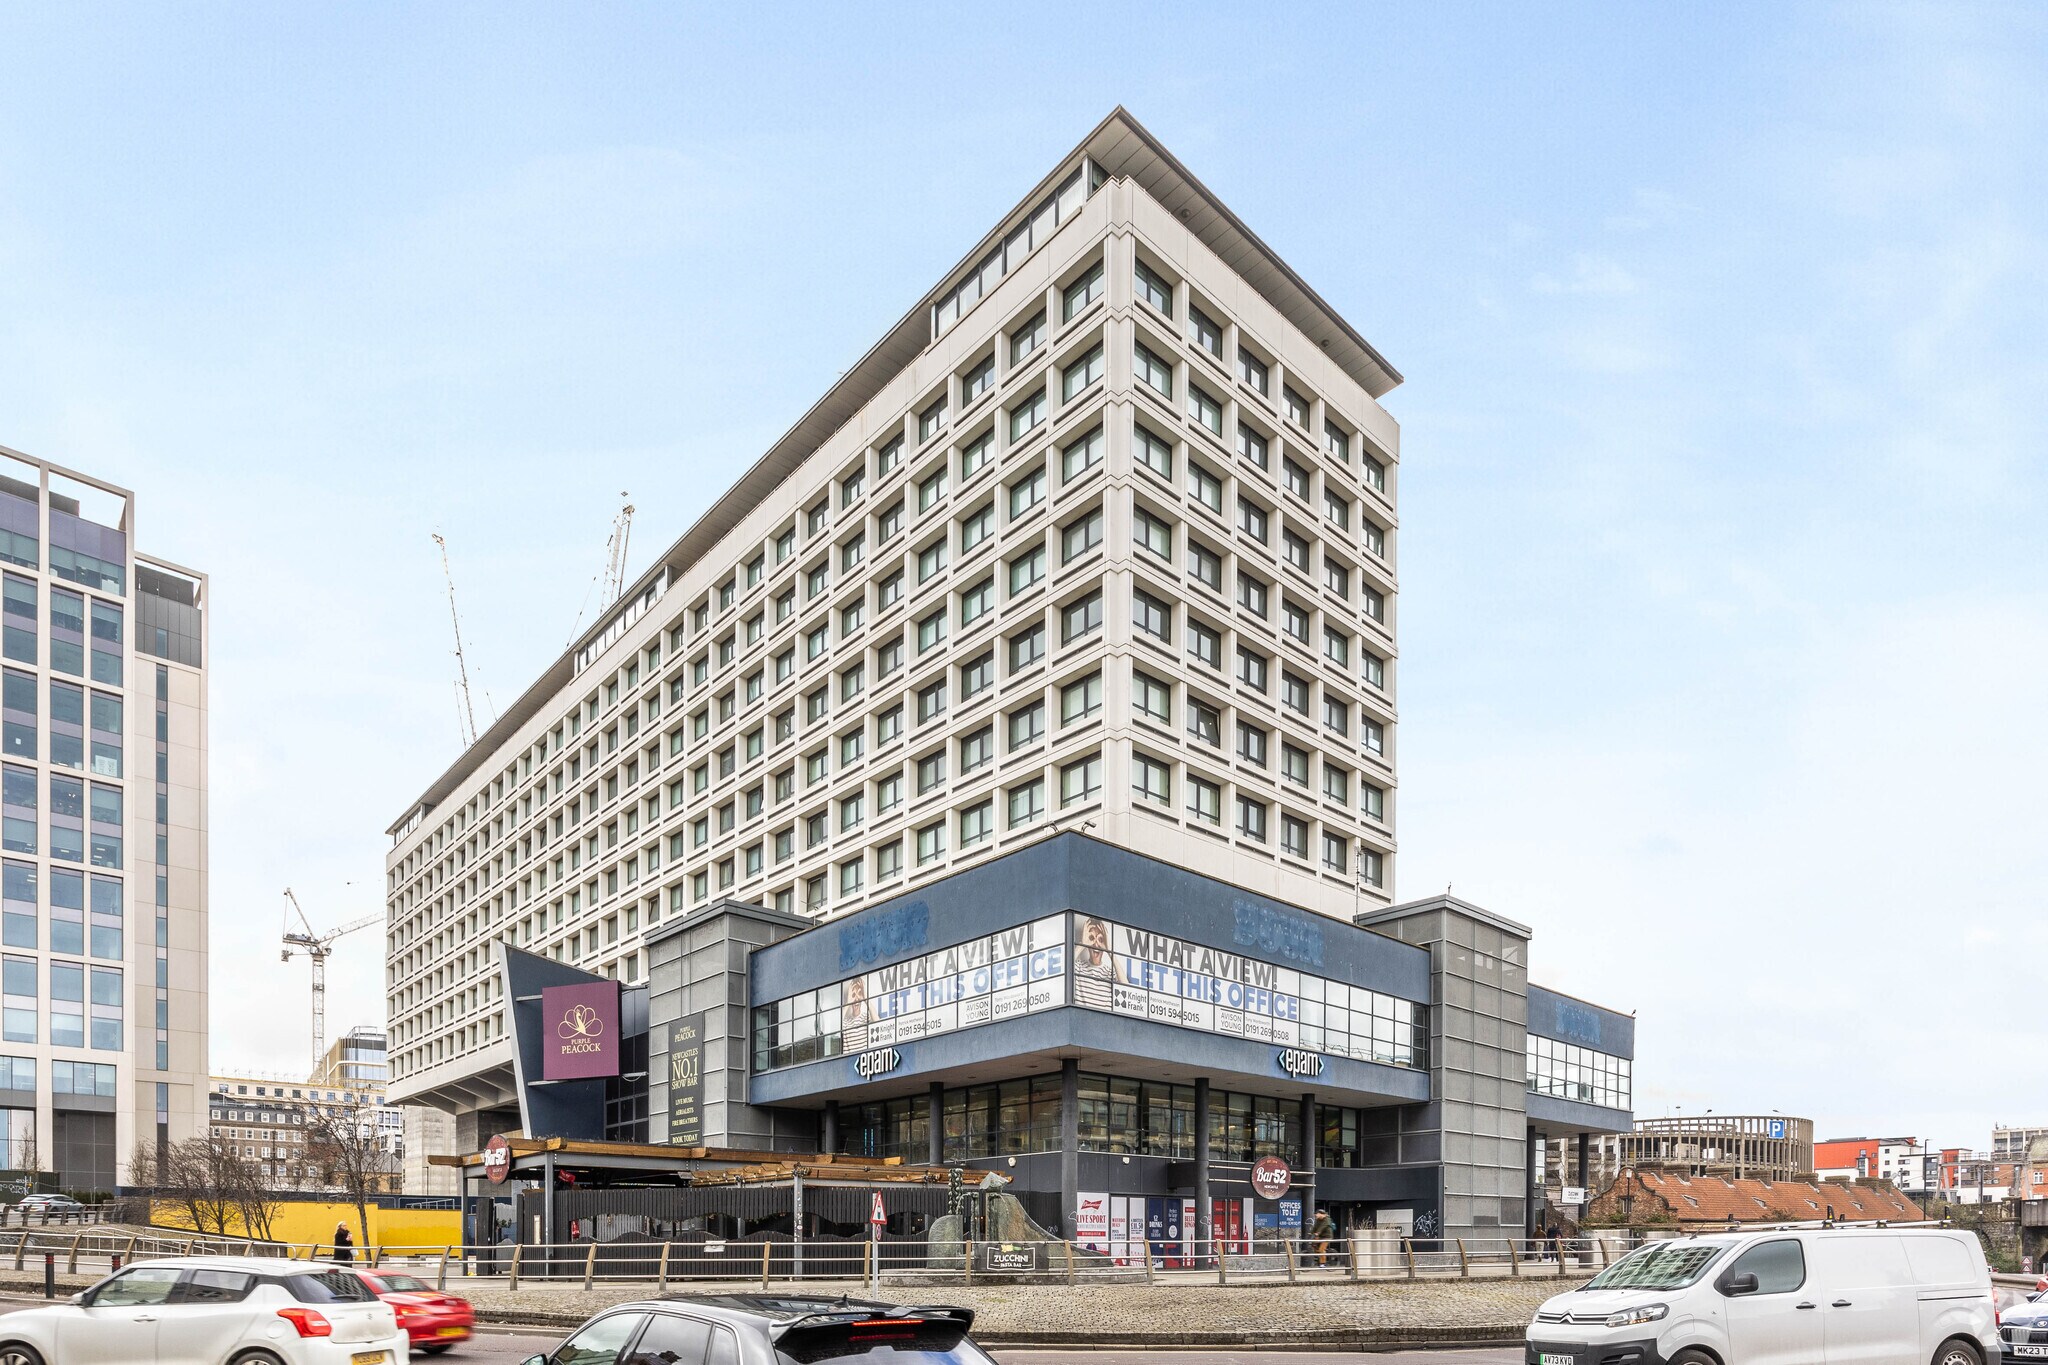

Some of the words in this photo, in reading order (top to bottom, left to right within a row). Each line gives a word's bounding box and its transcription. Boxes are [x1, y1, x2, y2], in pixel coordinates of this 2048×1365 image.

[878, 955, 939, 993] WHAT
[945, 949, 957, 975] A
[962, 926, 1035, 967] VIEW!
[1126, 929, 1196, 967] WHAT
[1200, 948, 1214, 974] A
[1217, 954, 1278, 990] VIEW!
[878, 985, 913, 1019] LET
[917, 973, 965, 1011] THIS
[973, 947, 1062, 993] OFFICE
[1127, 958, 1169, 994] LET
[1173, 970, 1221, 1004] THIS
[1228, 983, 1298, 1020] OFFICE
[994, 1002, 1012, 1015] 0191
[1029, 992, 1051, 1007] 0508
[1128, 992, 1147, 1004] Knight
[966, 1001, 989, 1012] AVISON
[1128, 1001, 1144, 1012] Frank
[966, 1010, 989, 1020] YOUNG
[1150, 1004, 1167, 1017] 0191
[1183, 1010, 1200, 1023] 5015
[1220, 1012, 1242, 1023] AVISON
[880, 1023, 895, 1034] Knight
[898, 1025, 913, 1037] 0191
[1220, 1020, 1242, 1031] YOUNG
[674, 1030, 696, 1043] PEACOCK
[880, 1033, 893, 1041] Frank
[1245, 1024, 1259, 1034] 0191
[1260, 1026, 1272, 1037] 269
[1273, 1029, 1289, 1040] 0508
[571, 1037, 591, 1045] PURPLE
[561, 1043, 601, 1055] PEACOCK
[672, 1056, 698, 1081] NO.1
[671, 1079, 687, 1090] SHOW
[687, 1076, 698, 1088] BAR
[672, 1135, 683, 1144] BOOK
[683, 1133, 698, 1143] TODAY
[1256, 1166, 1287, 1184] Bar52
[1279, 1201, 1301, 1210] OFFICES
[1076, 1214, 1089, 1224] LIVE
[1089, 1214, 1106, 1224] SPORT
[2017, 1346, 2040, 1355] MK23
